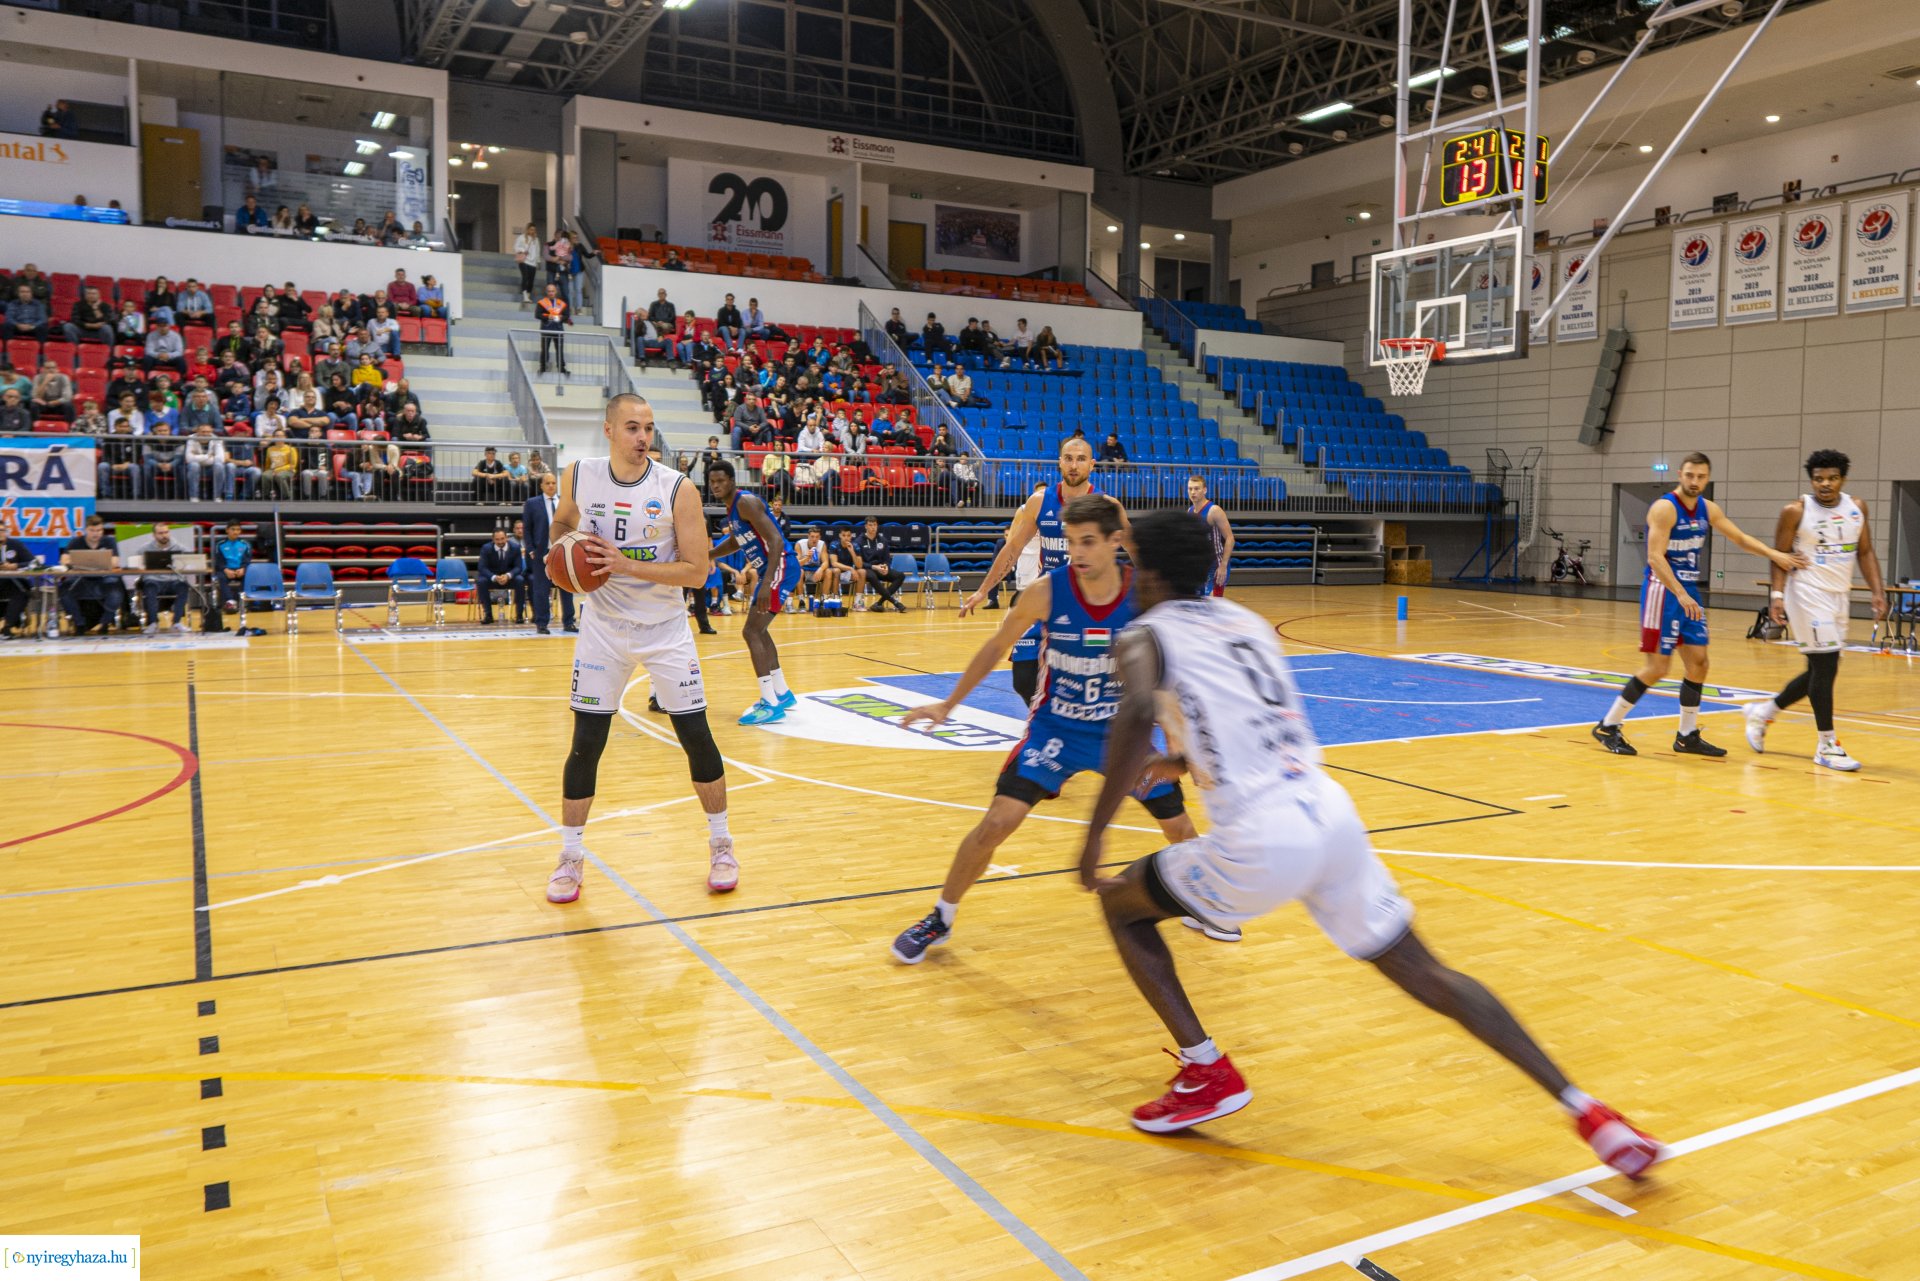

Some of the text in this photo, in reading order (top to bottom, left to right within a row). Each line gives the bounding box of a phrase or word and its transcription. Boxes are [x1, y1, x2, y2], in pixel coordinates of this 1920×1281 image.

[853, 138, 895, 153] Eissmann
[1455, 134, 1496, 162] 2:41
[1510, 135, 1546, 160] 2:1
[1461, 159, 1487, 193] 13
[1514, 161, 1539, 189] 1
[708, 172, 788, 232] 20
[736, 224, 784, 240] Eissmann
[1804, 273, 1819, 282] 2018
[1868, 265, 1884, 274] 2018
[1688, 287, 1702, 296] 2019
[1744, 281, 1759, 290] 2019
[1788, 285, 1807, 293] MAGYAR
[1853, 277, 1880, 286] MAGYAR
[1675, 298, 1691, 306] MAGYAR
[1731, 292, 1755, 300] MAGYAR
[0, 446, 75, 490] RÁ
[0, 498, 84, 537] ÁZA!
[614, 517, 627, 541] 6
[1671, 619, 1679, 637] 9
[571, 669, 580, 693] 6
[1230, 637, 1287, 707] 0
[1085, 677, 1102, 704] 6
